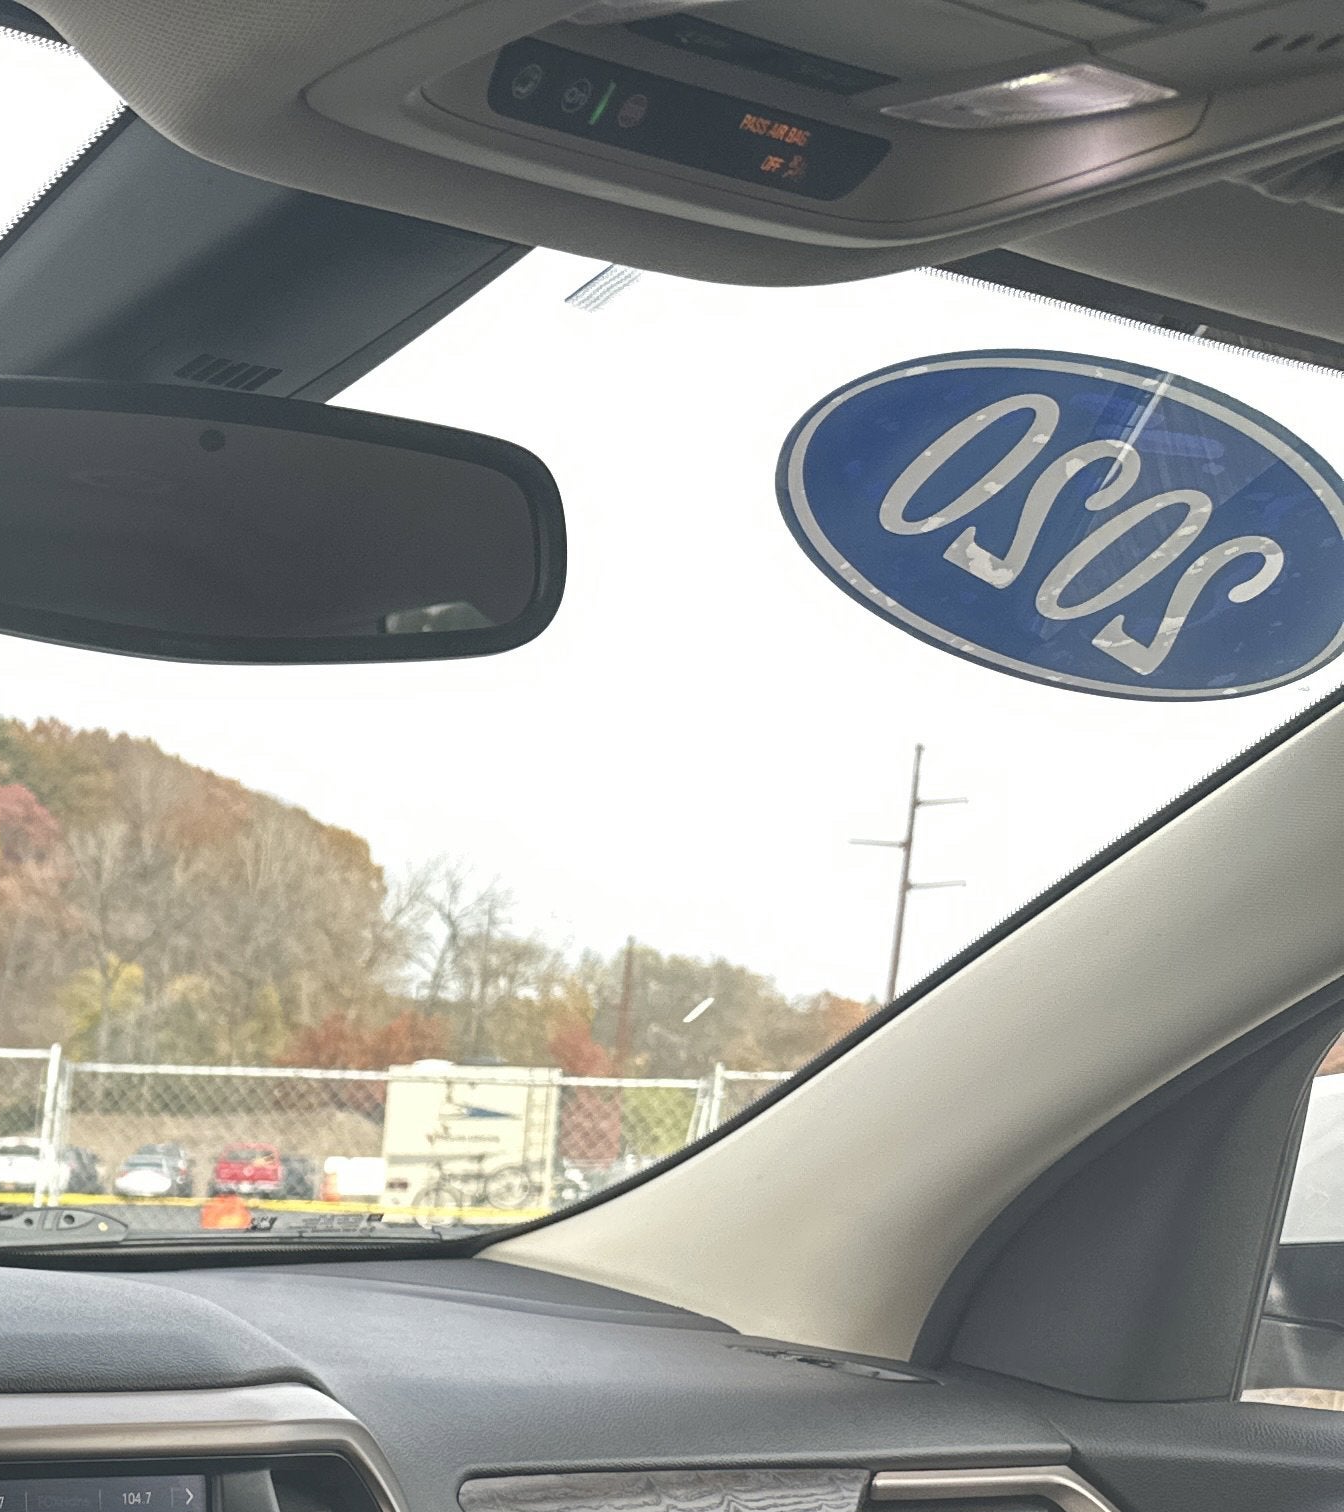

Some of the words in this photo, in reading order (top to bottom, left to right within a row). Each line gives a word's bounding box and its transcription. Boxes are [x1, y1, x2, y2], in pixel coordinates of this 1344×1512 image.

[740, 113, 770, 135] PASS
[769, 123, 789, 141] AIR
[785, 127, 810, 147] BAG
[760, 155, 785, 173] OFF
[122, 1491, 152, 1505] 104.7
